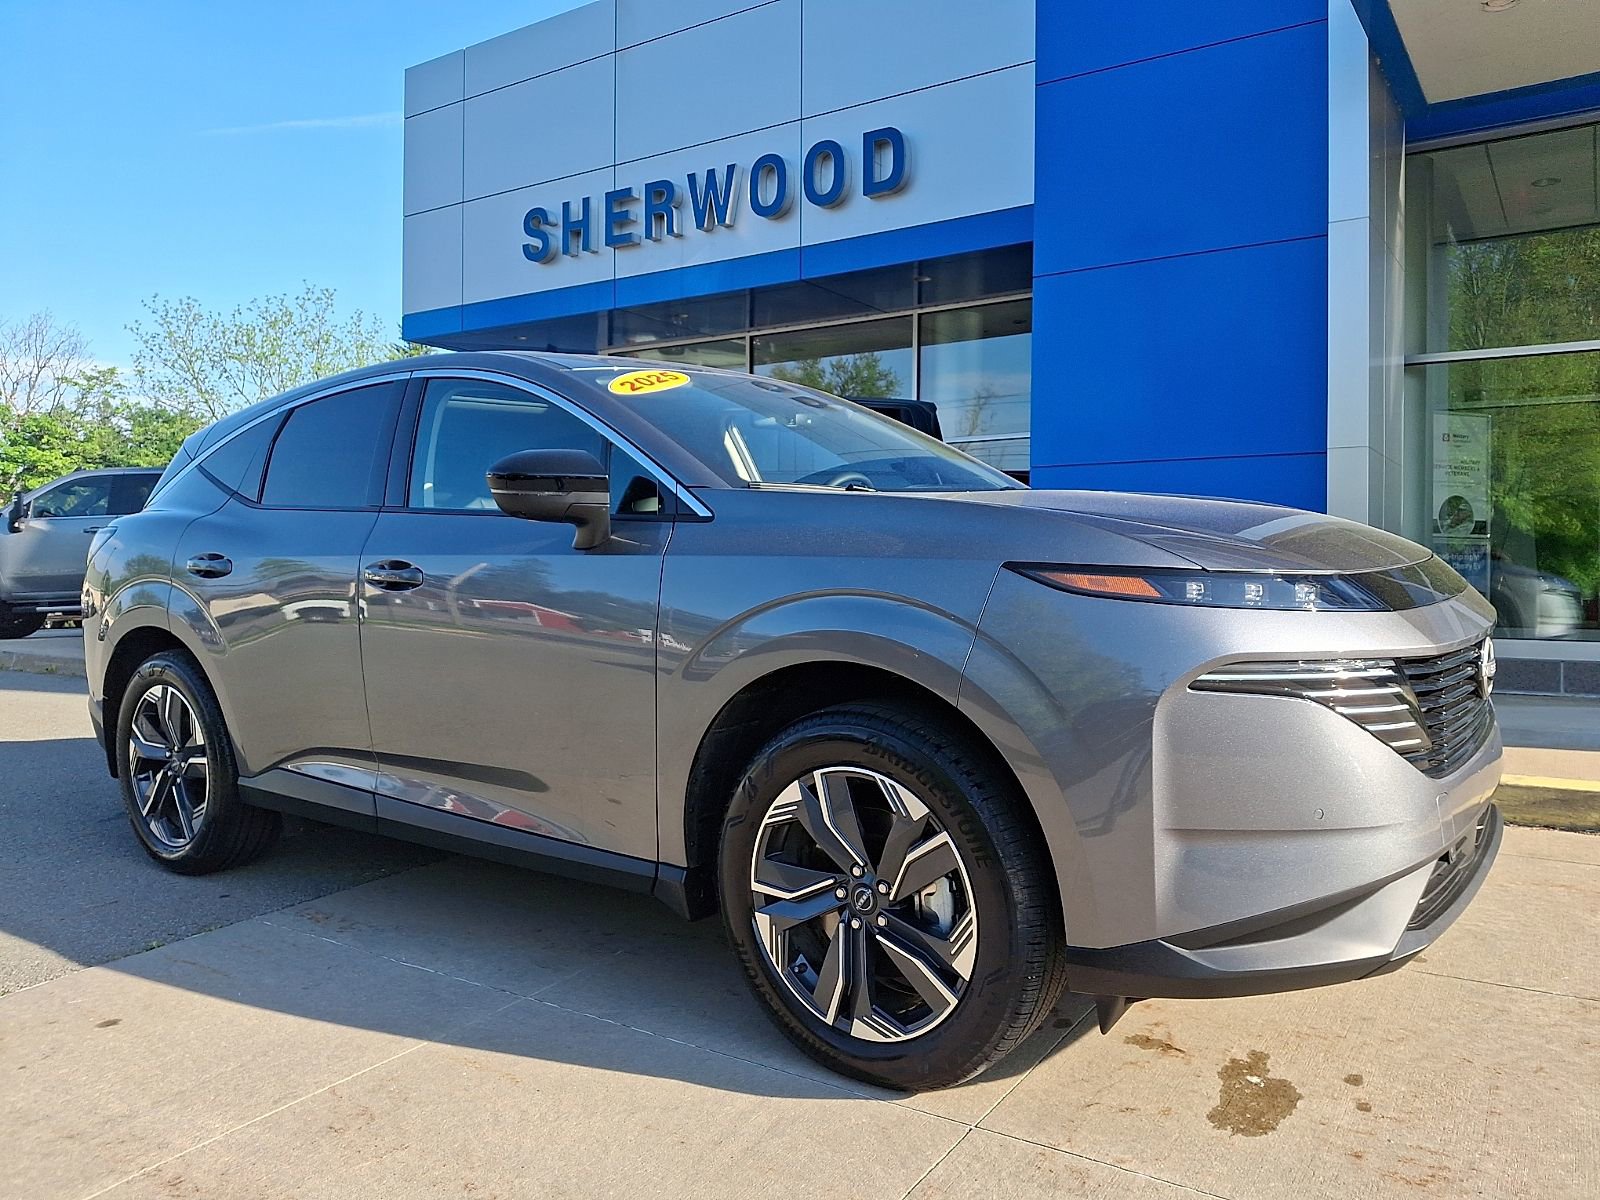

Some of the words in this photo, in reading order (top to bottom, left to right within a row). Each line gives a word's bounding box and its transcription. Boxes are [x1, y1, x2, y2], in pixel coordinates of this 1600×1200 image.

[522, 126, 911, 264] SHERWOOD
[620, 371, 679, 392] 2025
[862, 738, 993, 869] BRIDGESTONE
